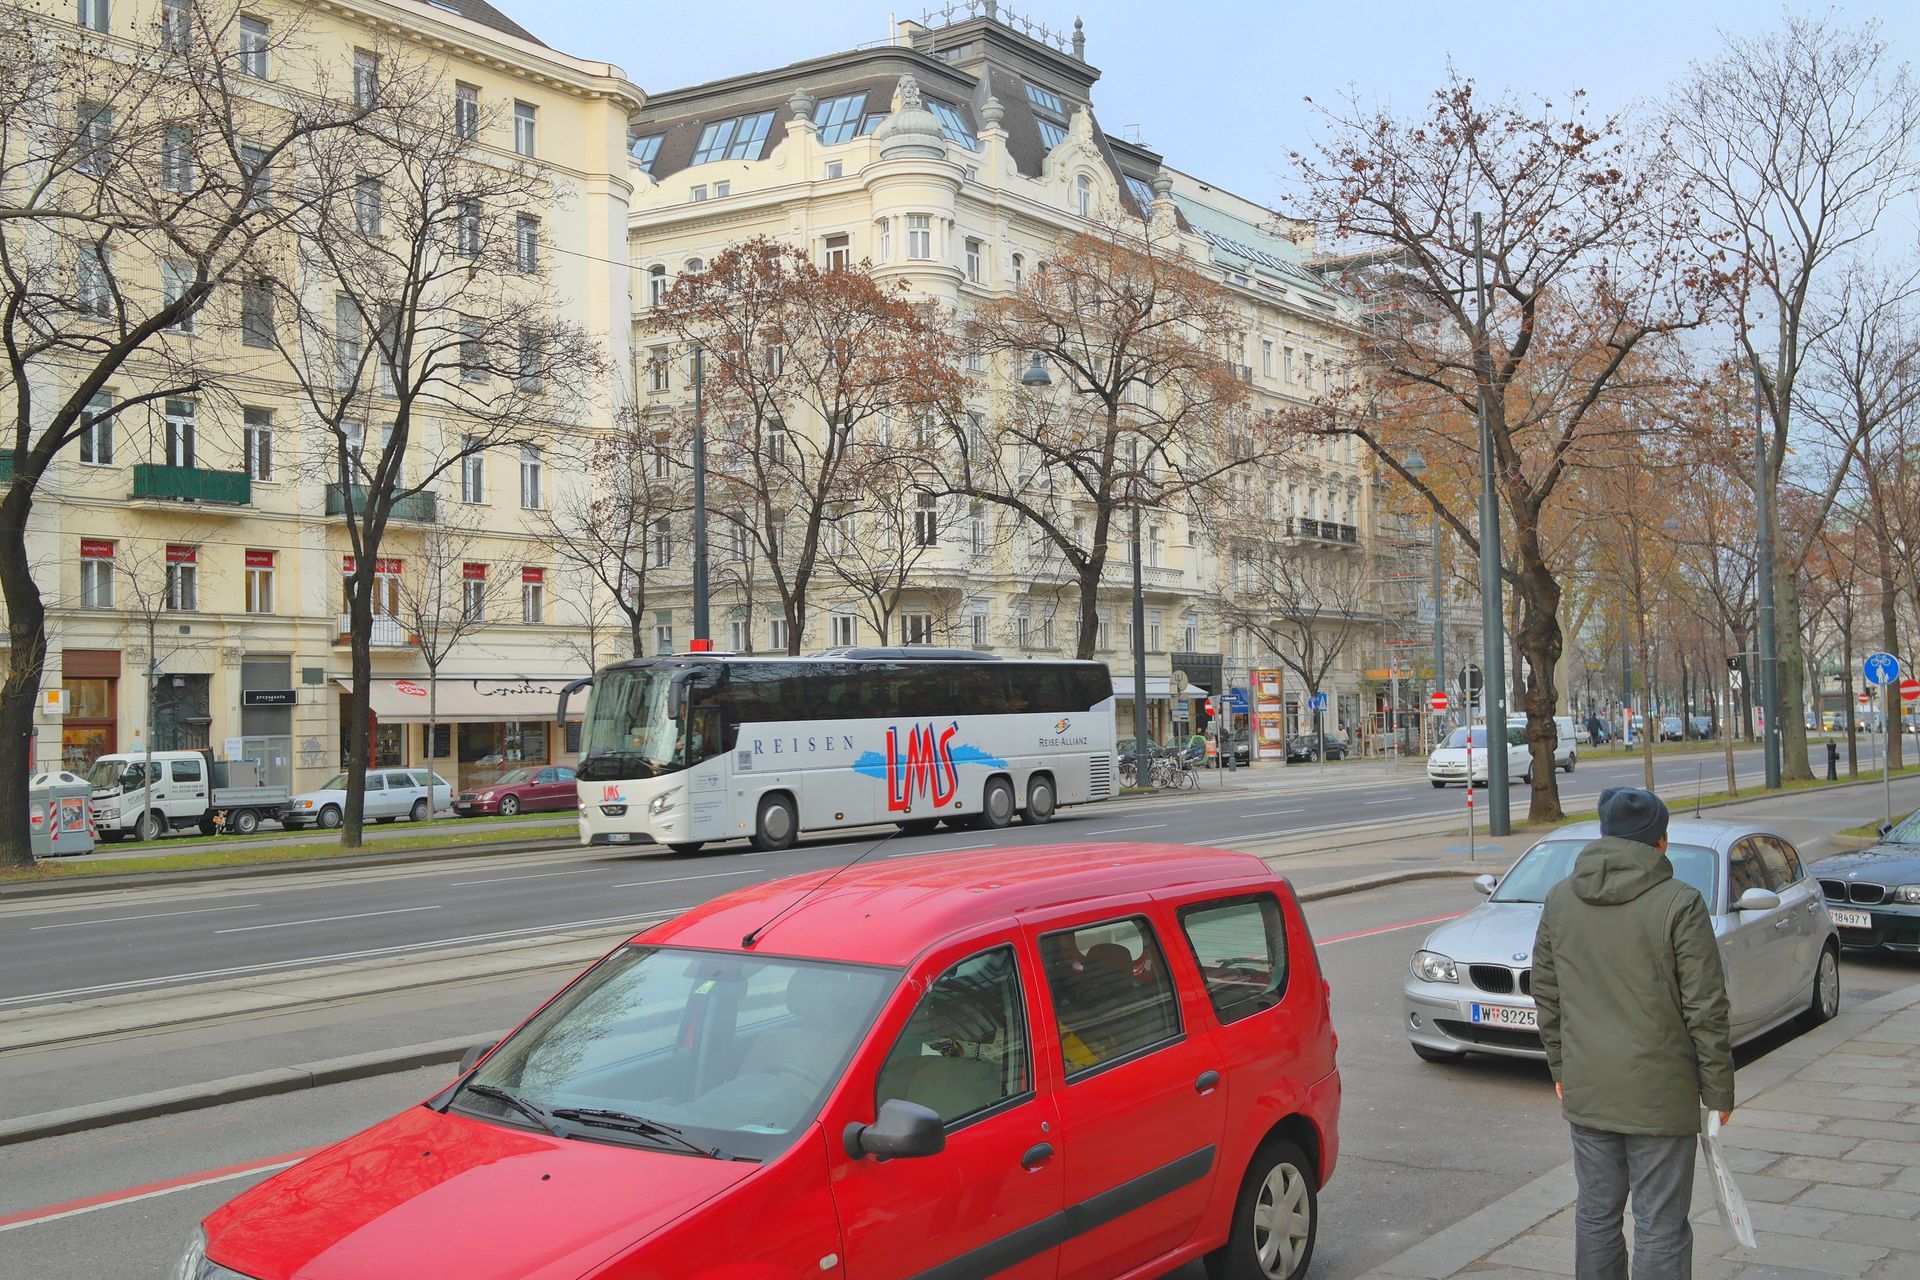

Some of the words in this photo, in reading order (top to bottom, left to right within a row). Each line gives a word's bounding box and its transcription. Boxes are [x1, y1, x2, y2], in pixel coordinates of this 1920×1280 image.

[753, 735, 854, 755] REISEN
[1039, 737, 1088, 748] REISE-ALLIANZ
[886, 720, 959, 812] LMS
[603, 784, 619, 802] LMS
[1835, 912, 1860, 924] 18497
[1862, 915, 1868, 925] Y
[1501, 1009, 1536, 1026] 9225
